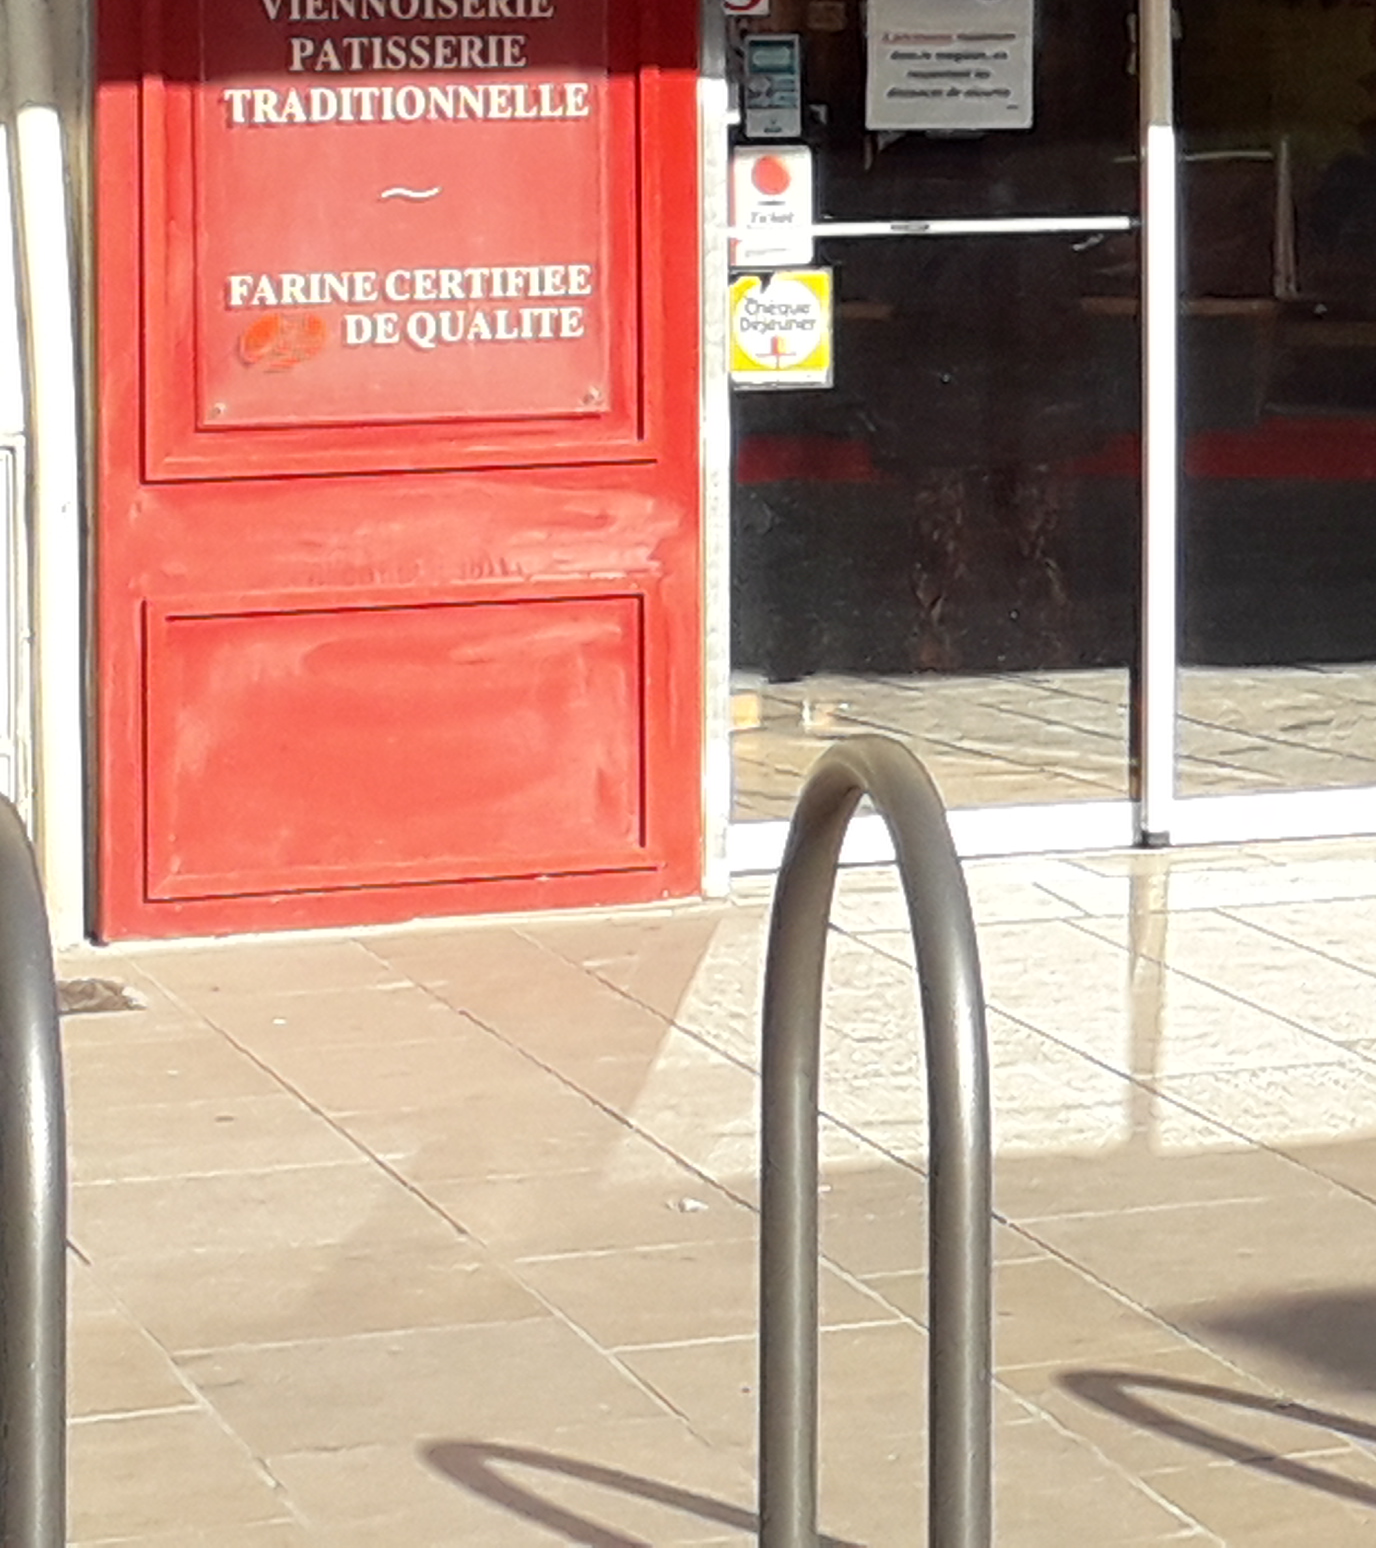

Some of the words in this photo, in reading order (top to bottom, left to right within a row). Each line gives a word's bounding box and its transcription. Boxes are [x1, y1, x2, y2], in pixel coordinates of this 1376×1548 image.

[288, 34, 528, 72] PATISSERIE
[223, 82, 590, 123] TRADITIONNELLE
[228, 271, 377, 307] FARINE
[384, 264, 592, 302] CERTIFIEE
[344, 312, 398, 345] DE
[406, 306, 584, 349] QUALITE
